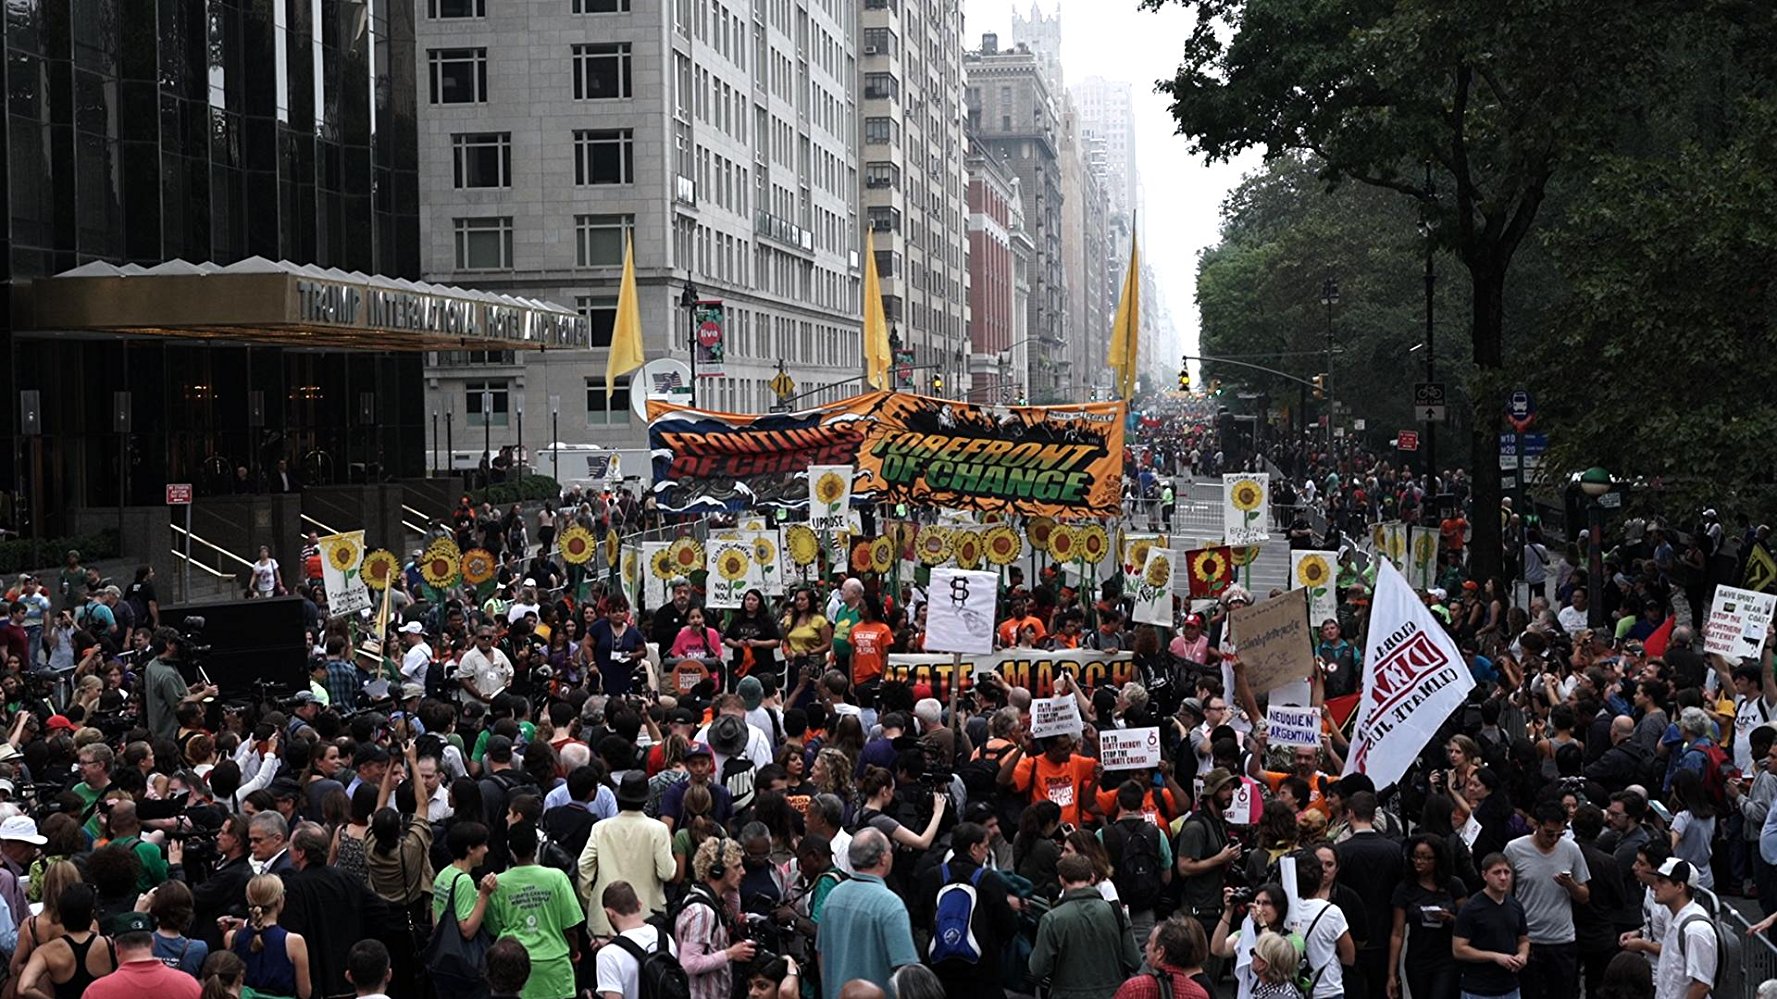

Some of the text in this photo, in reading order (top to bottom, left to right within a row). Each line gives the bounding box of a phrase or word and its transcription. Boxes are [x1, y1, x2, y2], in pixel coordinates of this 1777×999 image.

[297, 281, 588, 347] TRUMP INTERNATIONAL HOTEL AND TOWER
[700, 329, 718, 338] live
[659, 422, 865, 457] FRONTLINES
[1501, 434, 1516, 443] M10
[872, 431, 1099, 471] FOREFRONT
[1501, 446, 1516, 454] M20
[667, 443, 858, 479] OF CRISIS
[882, 453, 1089, 501] OF CHANGE
[811, 515, 844, 528] UPROSE
[1719, 590, 1736, 599] SAVE
[1712, 612, 1741, 623] STOP THE
[1269, 710, 1314, 728] NEUQUEN
[1270, 725, 1317, 744] ARGENTINA
[1102, 741, 1119, 750] DIRTY
[1119, 740, 1142, 749] ENERGY!
[1102, 749, 1128, 758] STOP THE
[1103, 755, 1147, 766] CLIMATE CRISIS!
[1047, 785, 1074, 798] CLIMATE
